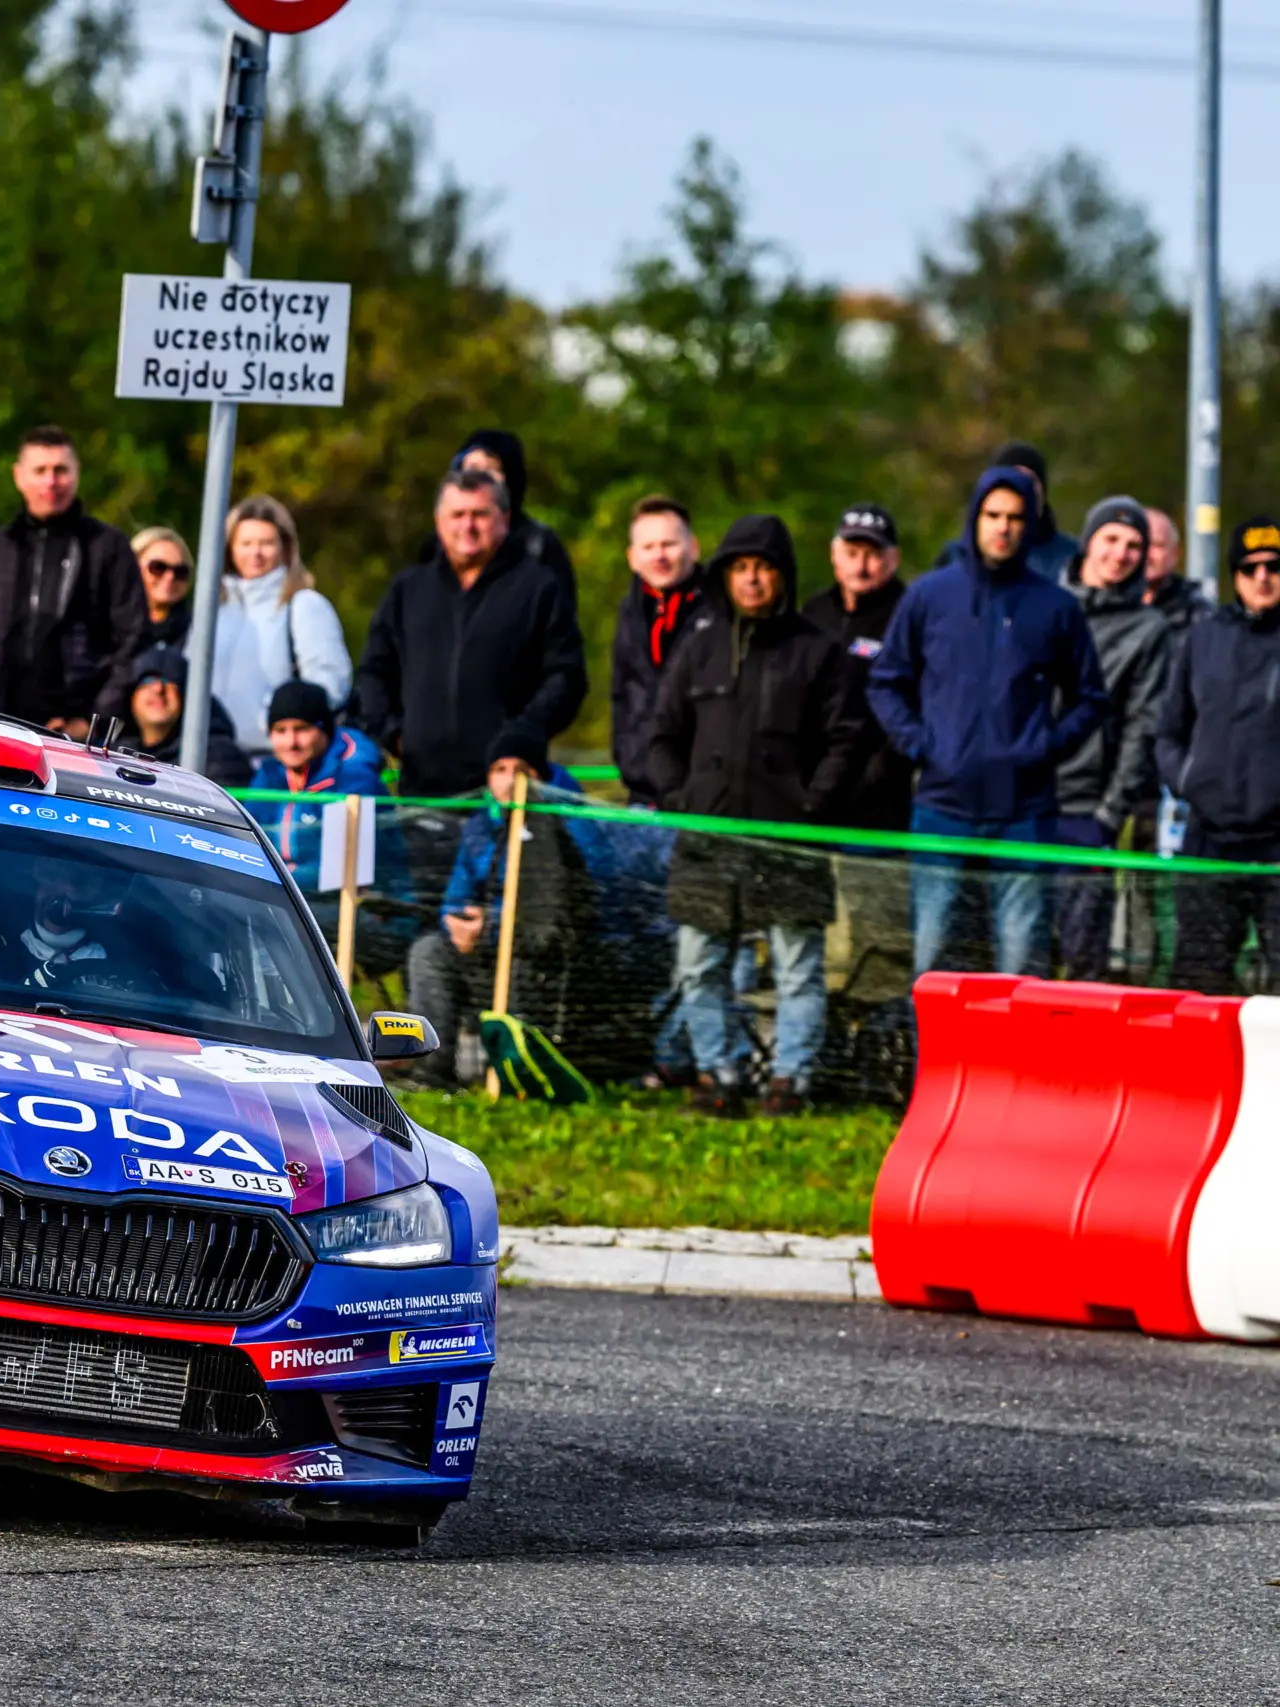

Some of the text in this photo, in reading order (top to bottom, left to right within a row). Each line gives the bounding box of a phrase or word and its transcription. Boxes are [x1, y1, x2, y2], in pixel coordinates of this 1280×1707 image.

[159, 282, 330, 323] Nie dotyczy
[154, 324, 330, 354] uczestników
[143, 358, 228, 396] Rajdu
[384, 1020, 418, 1029] RMF
[225, 1049, 267, 1064] 3
[129, 1169, 142, 1177] SK
[196, 1169, 215, 1184] S
[232, 1173, 283, 1193] 015
[336, 1291, 483, 1316] VOLKSWAGEN FINANCIAL SERVICES
[419, 1335, 476, 1351] MICHELIN
[436, 1438, 476, 1454] ORLEN
[295, 1459, 344, 1478] verva
[445, 1456, 459, 1467] OIL
